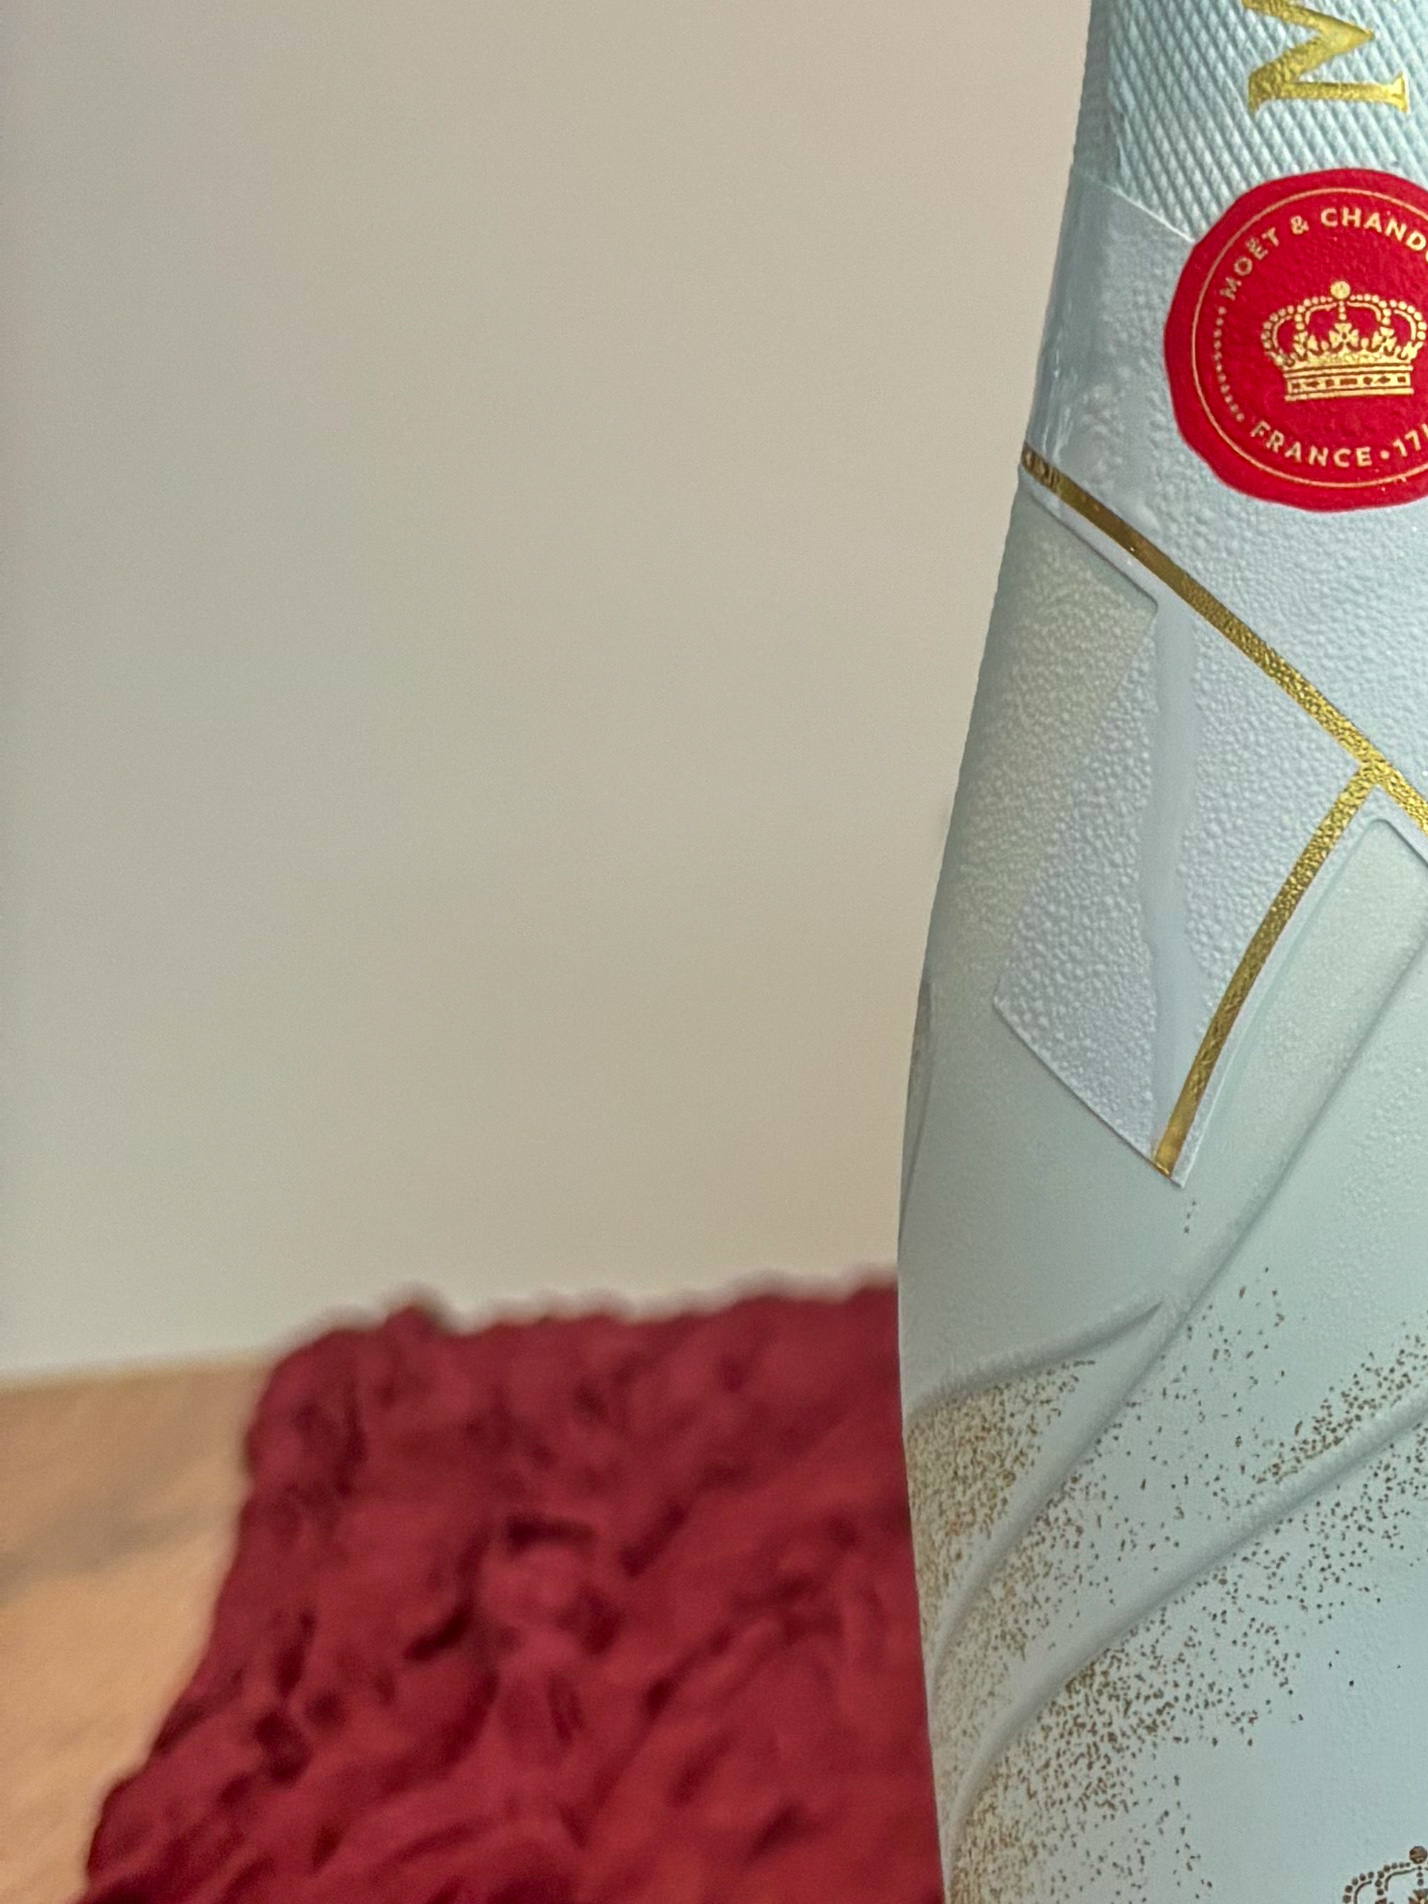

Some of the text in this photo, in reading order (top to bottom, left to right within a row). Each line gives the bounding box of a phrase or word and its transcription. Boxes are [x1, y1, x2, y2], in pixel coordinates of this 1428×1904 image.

[1220, 227, 1280, 301] MOËT
[1290, 215, 1309, 236] &
[1250, 420, 1372, 468] FRANCE
